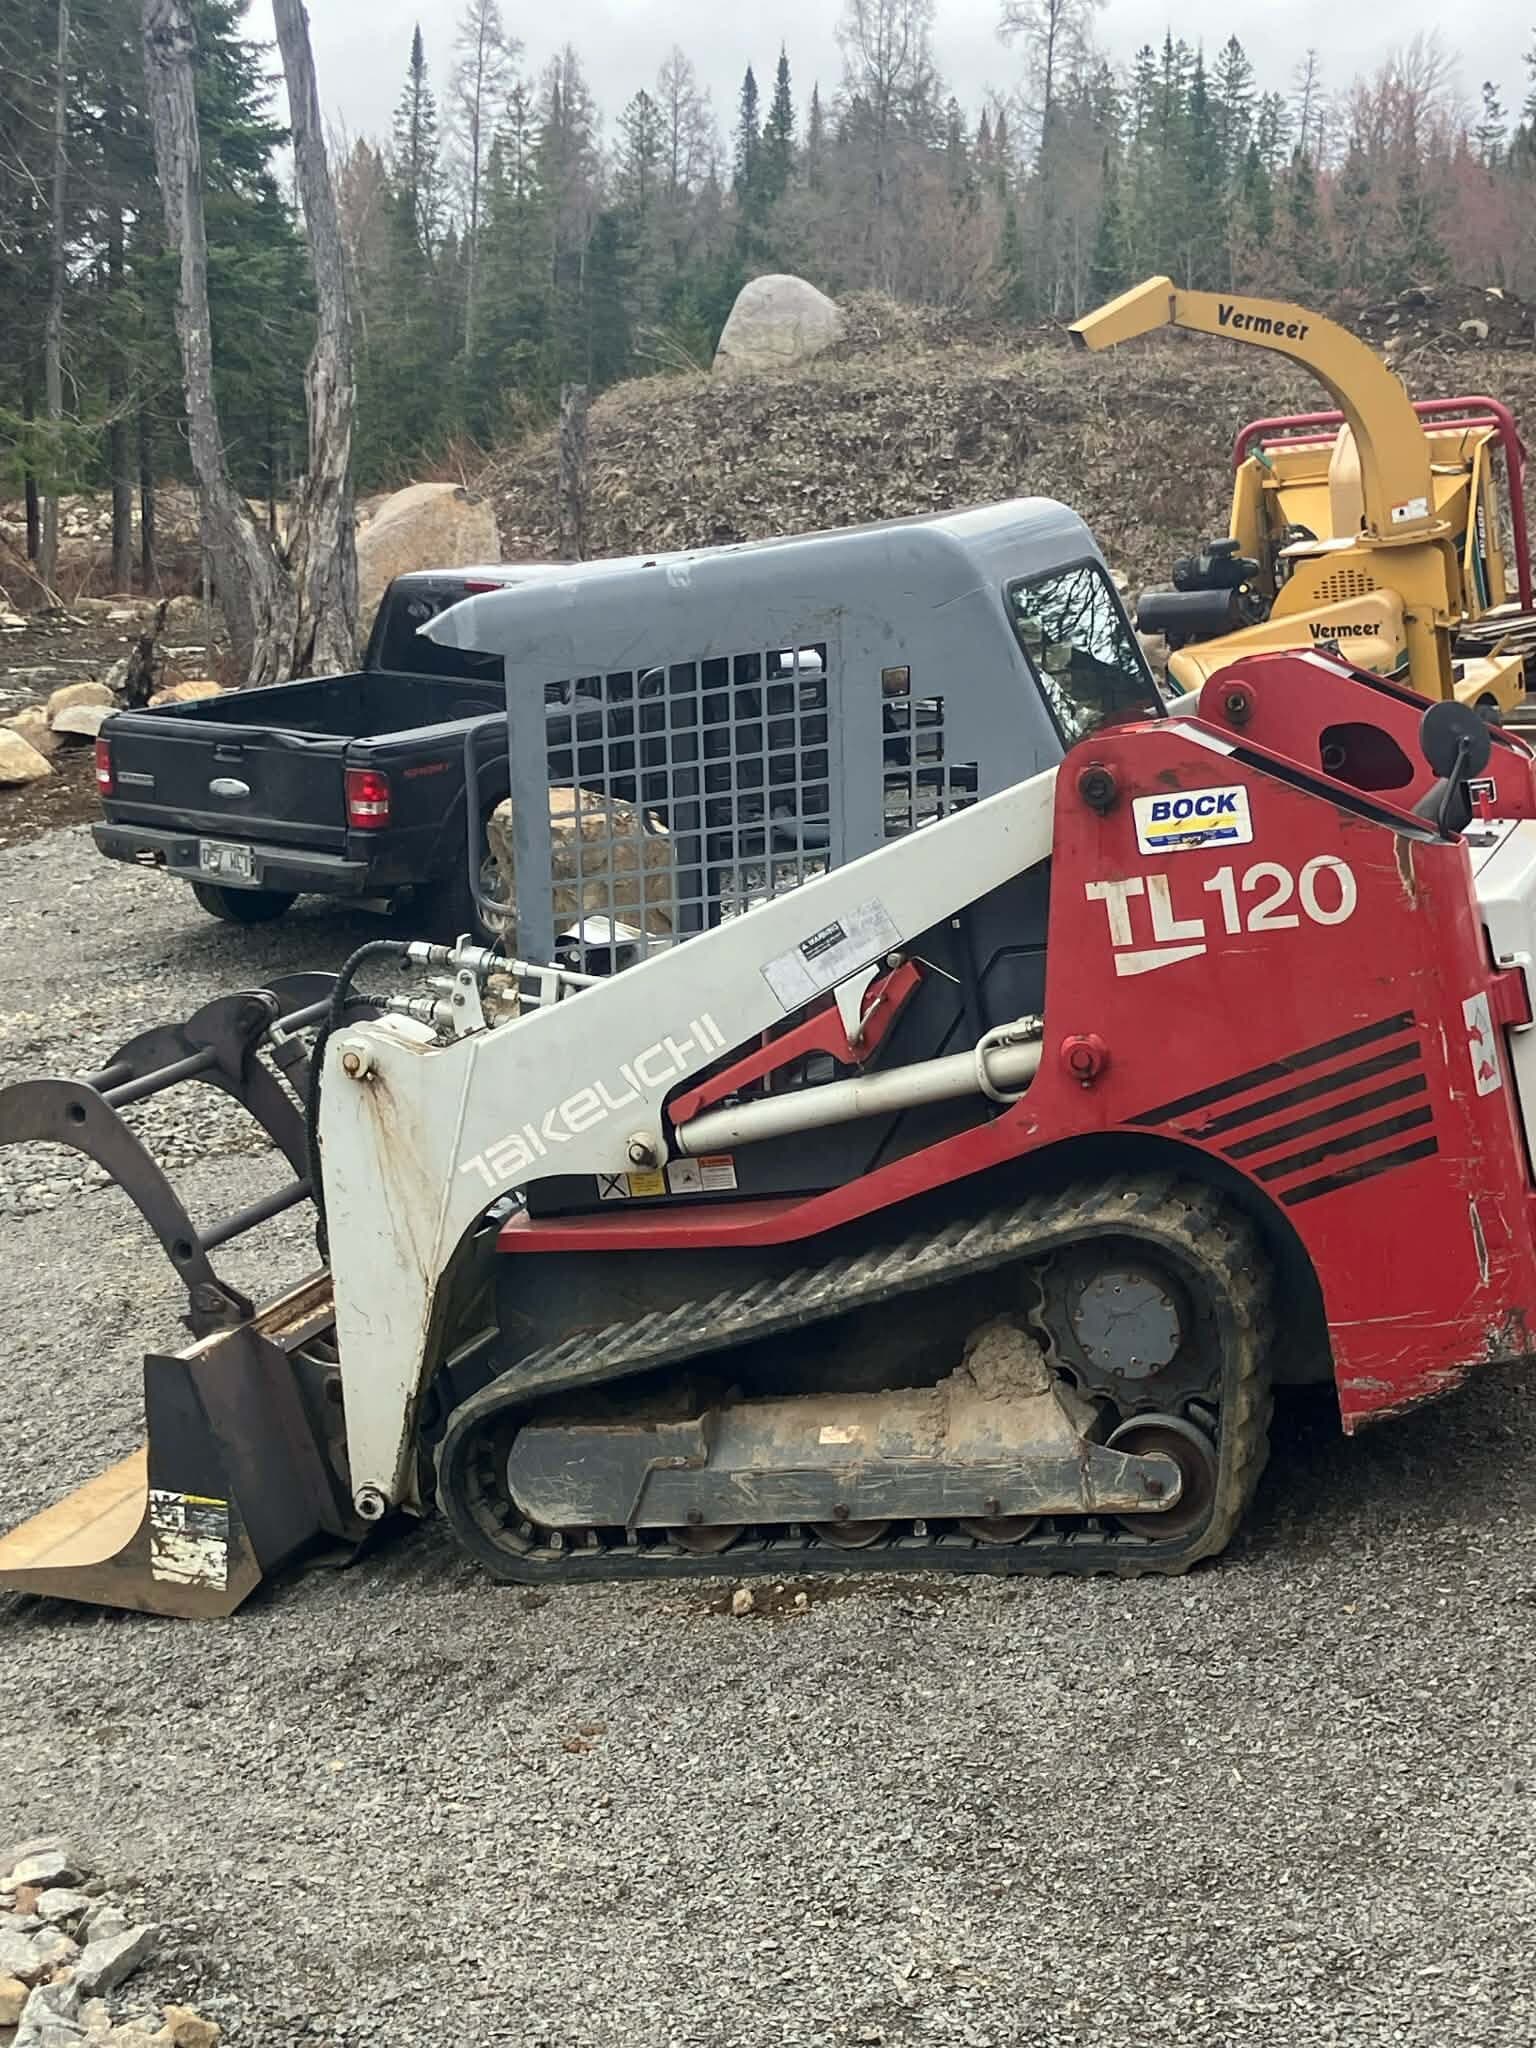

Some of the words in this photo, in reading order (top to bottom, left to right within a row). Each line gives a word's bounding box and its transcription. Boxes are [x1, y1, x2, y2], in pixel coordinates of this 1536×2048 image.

[1218, 303, 1309, 341] Vermeer
[1309, 623, 1381, 639] Vermeer
[1151, 792, 1237, 822] BOCK
[1085, 855, 1357, 947] TL120
